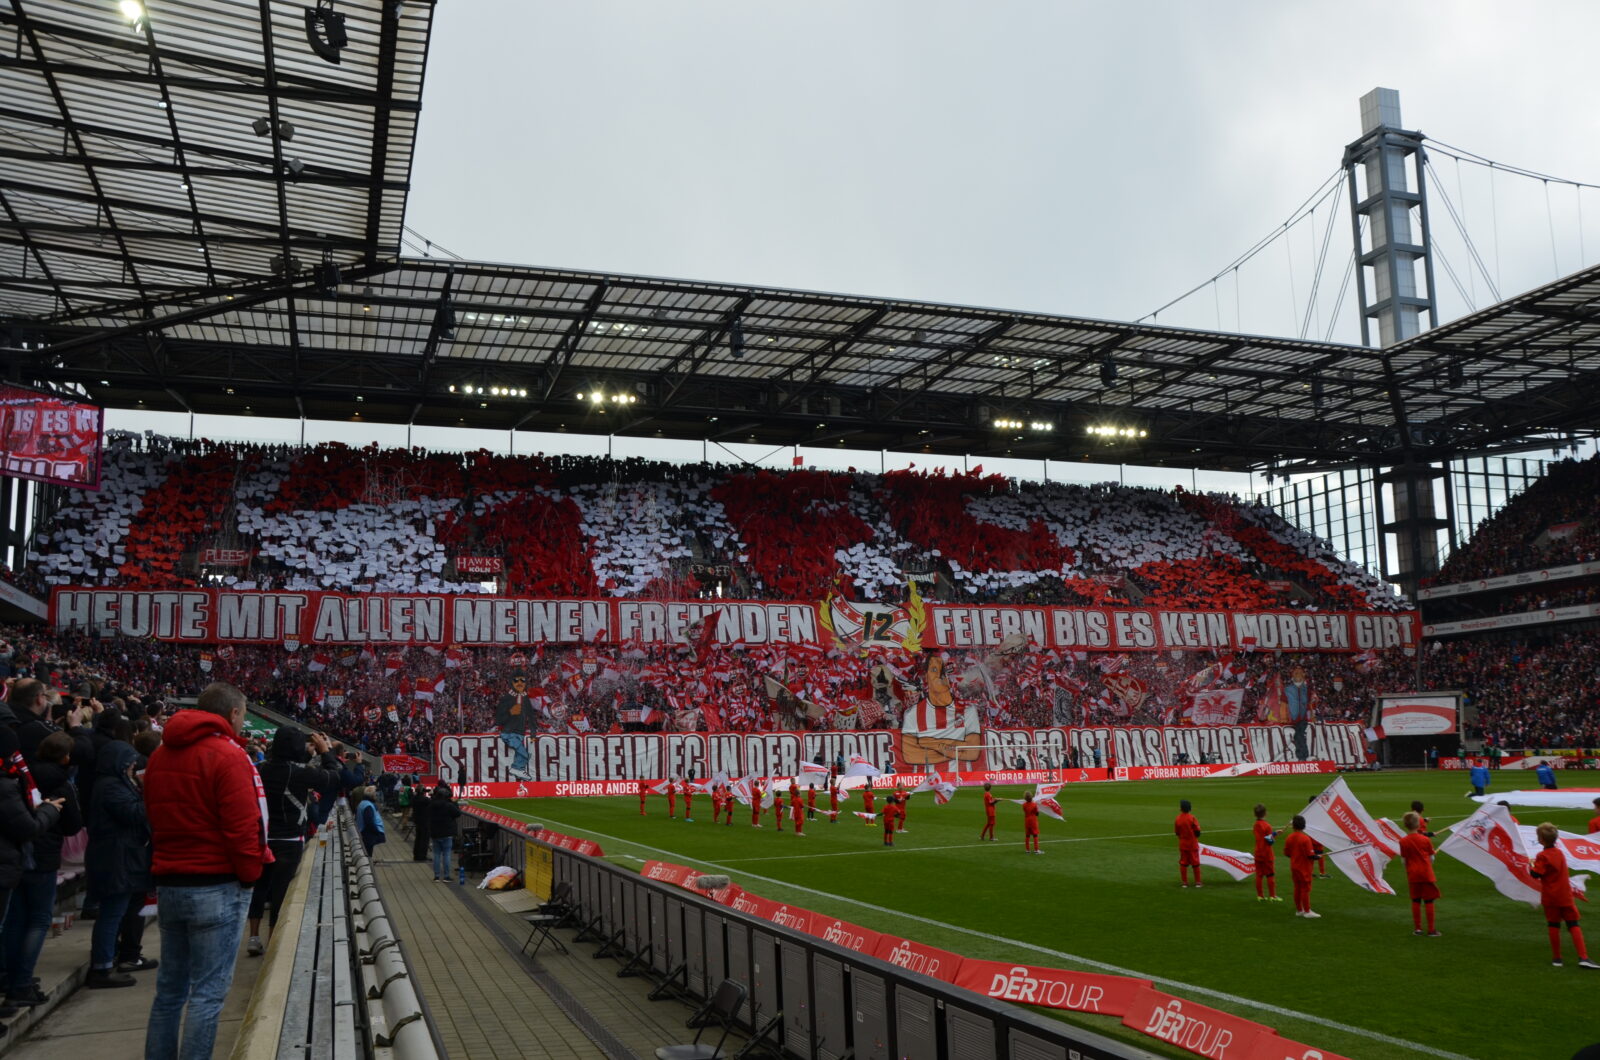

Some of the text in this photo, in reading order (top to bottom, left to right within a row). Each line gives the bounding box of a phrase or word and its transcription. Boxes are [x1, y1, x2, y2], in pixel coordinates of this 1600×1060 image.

[457, 557, 501, 570] HAWKS
[57, 592, 209, 639] HEUTE
[217, 594, 307, 640] MIT
[314, 597, 444, 643] ALLEN
[453, 599, 610, 643] MEINEN
[862, 611, 893, 641] 12
[932, 608, 1415, 650] FEIERN BIS ES KEIN MORGEN GIBT
[526, 733, 579, 782] ICH
[585, 734, 665, 782] BEIM
[667, 733, 706, 781] FC
[708, 733, 744, 779] IN
[746, 733, 799, 778] DER
[985, 729, 1036, 771] DER
[1034, 728, 1070, 771] FC
[1070, 729, 1111, 769] IST
[1115, 728, 1162, 767] DAS
[1250, 726, 1296, 764] WAS
[1144, 766, 1179, 778] SPÜRBAR
[1257, 761, 1322, 774] SPÜRBAR ANDERS.
[555, 782, 602, 796] SPÜRBAR
[823, 922, 865, 951] DERTOUR
[888, 941, 940, 977] DERTOUR
[988, 967, 1104, 1011] DERTOUR
[1145, 1000, 1233, 1060] DERTOUR
